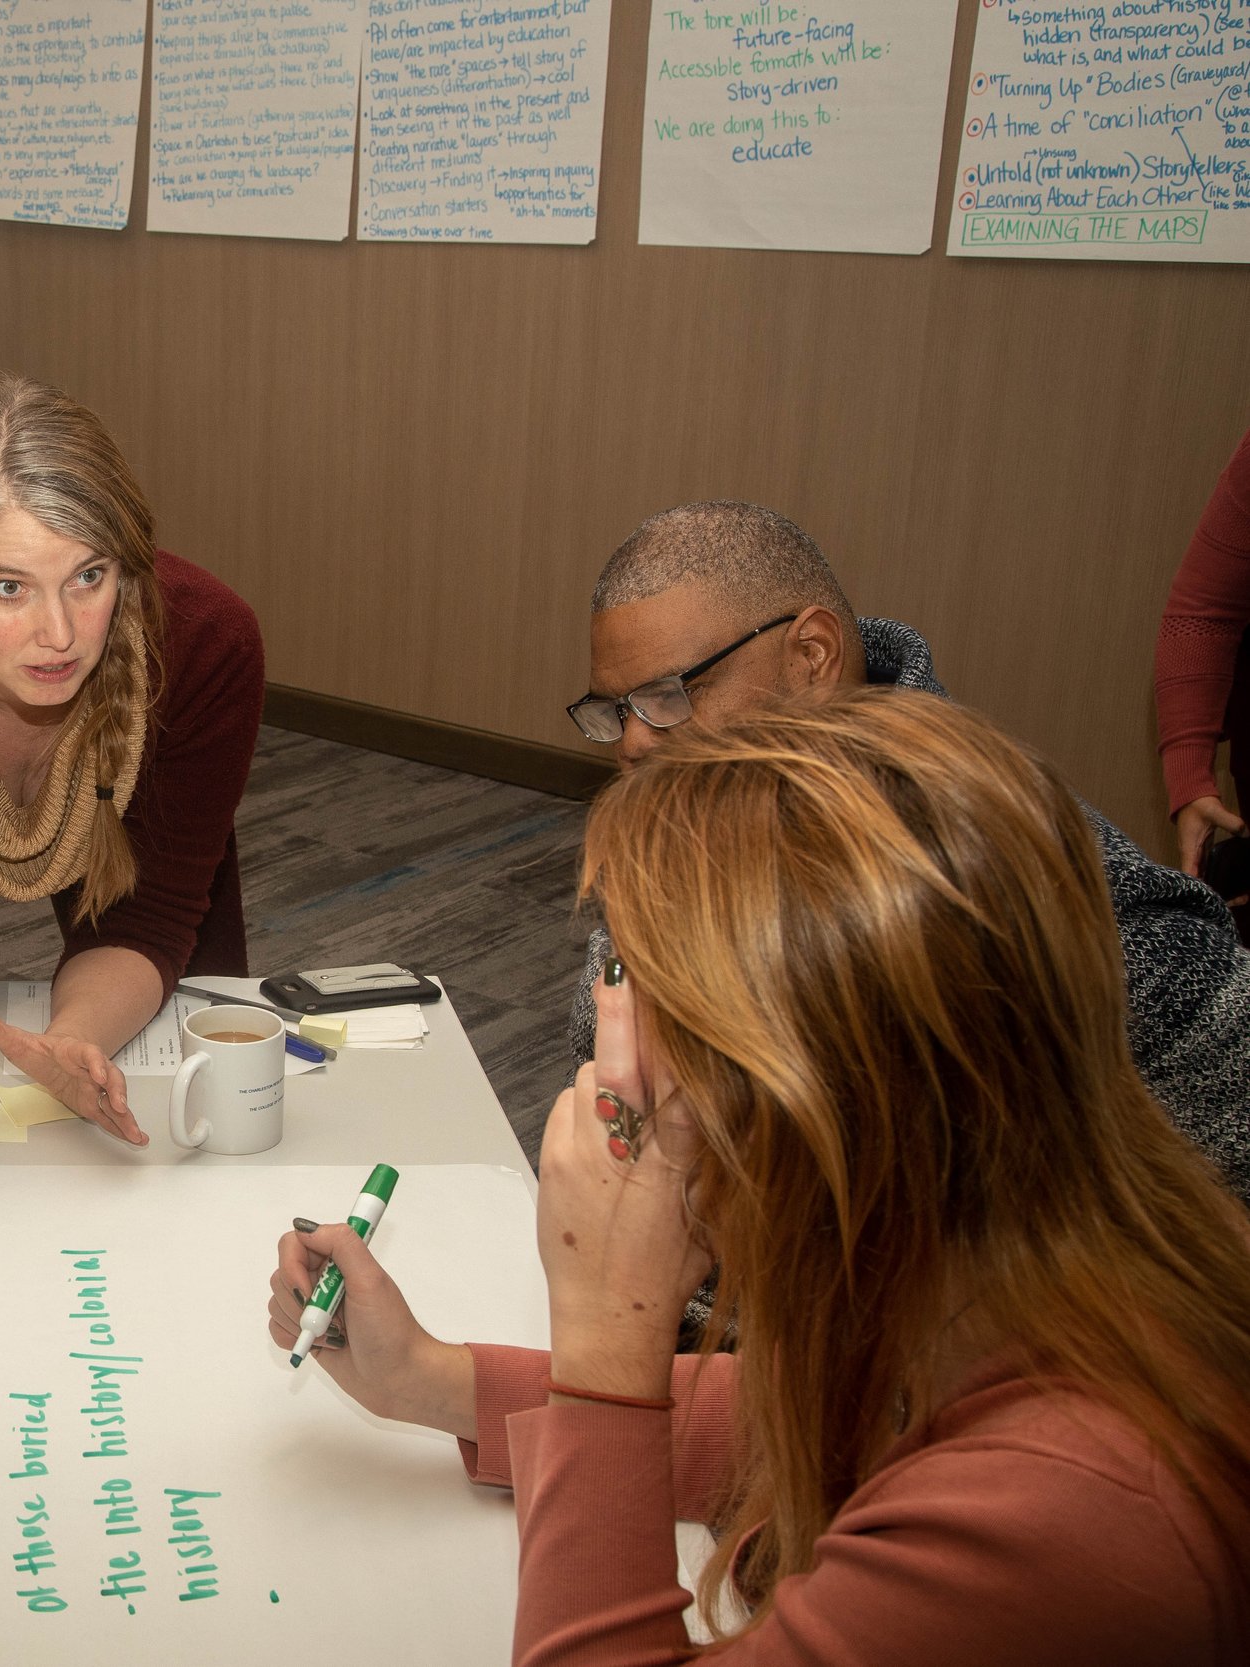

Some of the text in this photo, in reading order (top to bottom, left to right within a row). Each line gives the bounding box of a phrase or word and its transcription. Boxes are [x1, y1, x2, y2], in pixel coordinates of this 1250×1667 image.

[370, 21, 388, 45] Ppl
[391, 19, 425, 41] often
[427, 20, 456, 35] come
[460, 9, 475, 30] for
[478, 2, 562, 26] entertainment,
[563, 0, 591, 15] but
[662, 5, 807, 33] The tone will be:
[1112, 1, 1165, 18] about
[1168, 0, 1231, 19] history
[6, 23, 33, 39] space
[47, 13, 93, 34] important
[732, 17, 856, 51] future-facing
[1023, 25, 1081, 47] hidden
[1090, 13, 1210, 45] (transparency)
[371, 25, 572, 64] leave/are impacted by education
[658, 39, 892, 81] Accessible format/s will be:
[1023, 38, 1224, 67] what is, and what could
[369, 68, 399, 85] Show
[458, 58, 498, 79] spaces
[512, 51, 531, 70] tell
[535, 52, 565, 72] story
[569, 38, 589, 60] of
[371, 62, 575, 105] uniqueness (differentiation) cool
[989, 74, 1052, 110] "Turning
[1059, 75, 1094, 104] Up"
[1096, 70, 1166, 97] Bodies
[370, 87, 591, 124] Look at something in the present and
[370, 107, 572, 139] then seeing it in the past as well
[654, 103, 841, 143] We are doing this to:
[982, 112, 998, 140] A
[1004, 113, 1041, 137] time
[1051, 110, 1076, 134] of
[369, 142, 410, 161] Creating
[413, 139, 459, 153] narrative
[507, 126, 558, 155] through
[732, 135, 814, 165] educate
[1039, 147, 1077, 162] Unsung
[178, 173, 193, 185] are
[249, 165, 263, 179] the
[372, 152, 483, 175] different mediums
[977, 151, 1247, 187] Untold (not unknown) Storytellers
[369, 164, 596, 198] Discovery Finding it Inspiring inquiry
[503, 184, 586, 205] opportunities for
[370, 198, 489, 223] Conversation starters
[551, 205, 597, 219] moments
[975, 189, 1043, 216] Learning
[1047, 185, 1093, 208] About
[1096, 185, 1138, 209] Each
[1142, 185, 1199, 207] Other
[369, 224, 494, 240] Showing change over time
[970, 215, 1199, 243] EXAMINING THE MAPS
[327, 1274, 339, 1287] dry
[60, 1248, 144, 1458] history/colonial
[9, 1391, 69, 1613] of those buried
[163, 1487, 222, 1603] history
